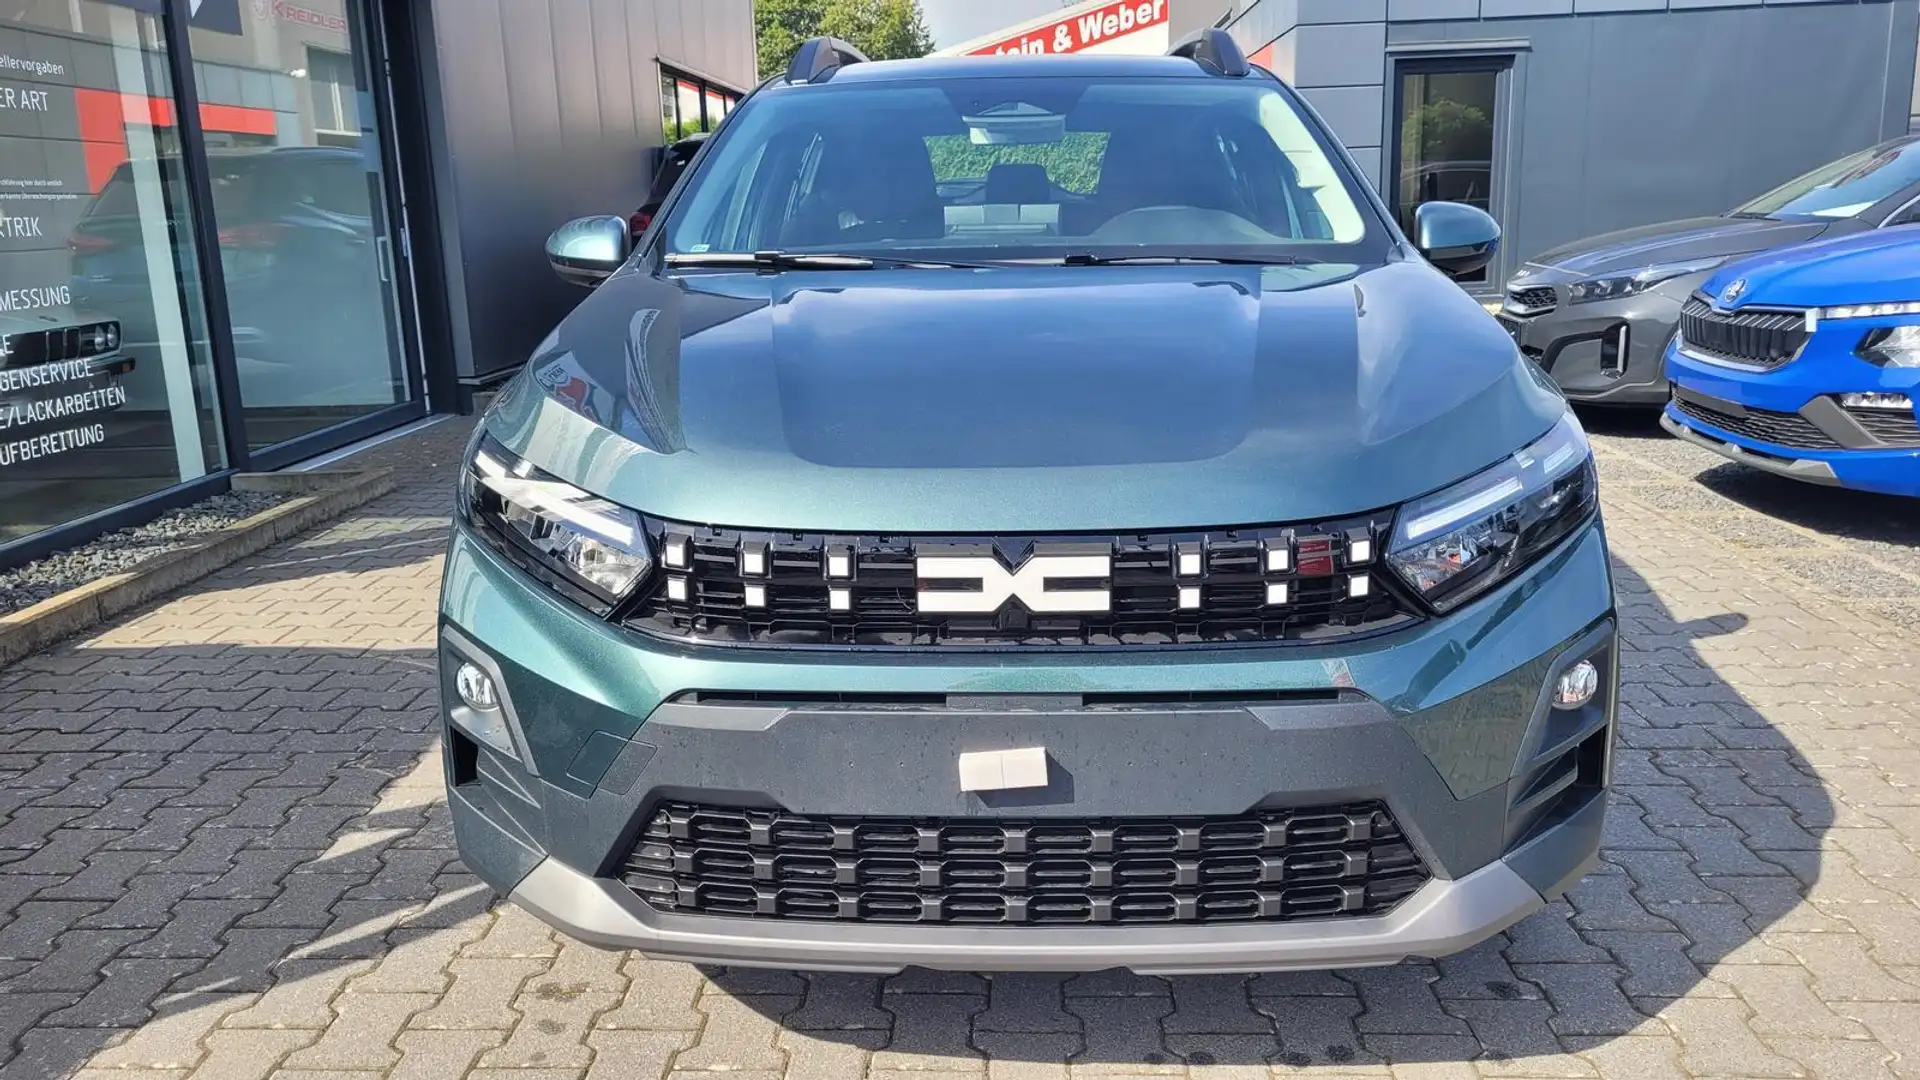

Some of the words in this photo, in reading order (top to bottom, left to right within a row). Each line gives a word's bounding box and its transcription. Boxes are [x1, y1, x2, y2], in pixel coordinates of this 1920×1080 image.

[1053, 24, 1073, 53] &
[1077, 0, 1166, 44] Weber
[21, 89, 48, 112] ART
[0, 216, 42, 237] TRIK
